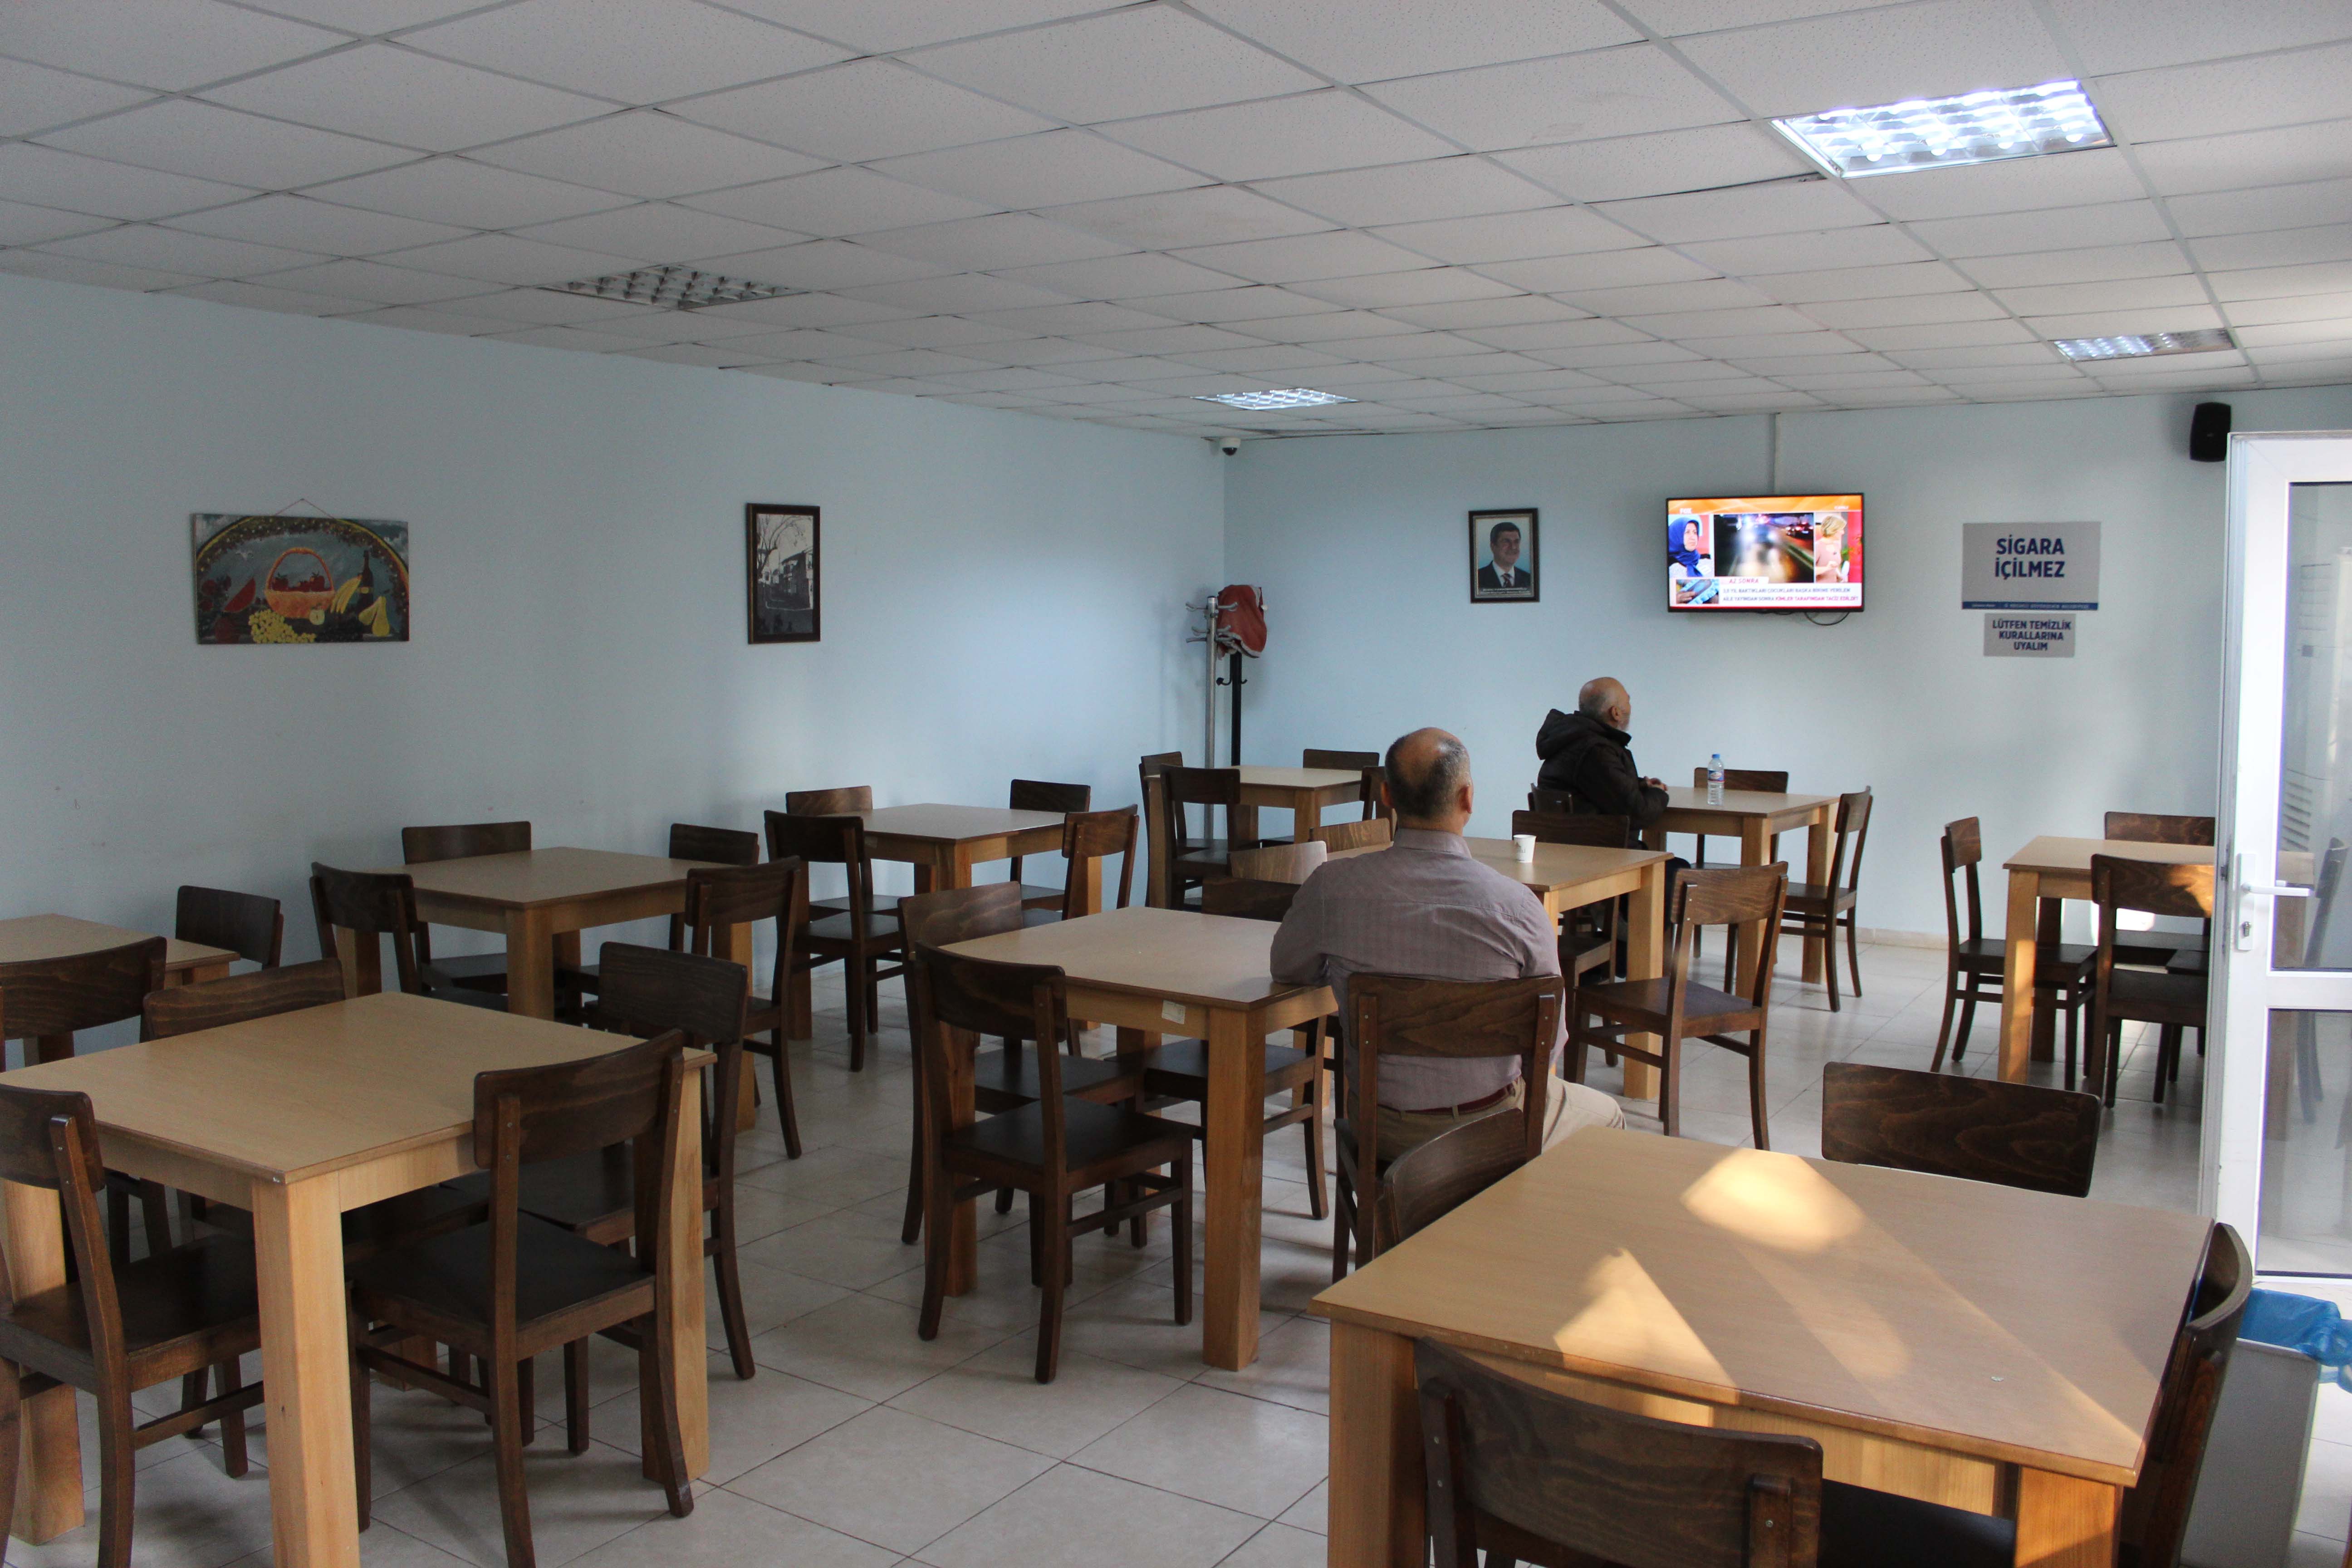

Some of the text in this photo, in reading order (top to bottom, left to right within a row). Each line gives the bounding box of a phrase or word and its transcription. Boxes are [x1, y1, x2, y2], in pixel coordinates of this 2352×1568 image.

[1996, 534, 2064, 554] SİGARA
[1995, 558, 2065, 580] İÇİLMEZ
[1992, 618, 2072, 630] LÜTFEN TEMİZLİK
[1999, 631, 2064, 640] KURALLARINA
[2014, 642, 2048, 650] UYALIM
